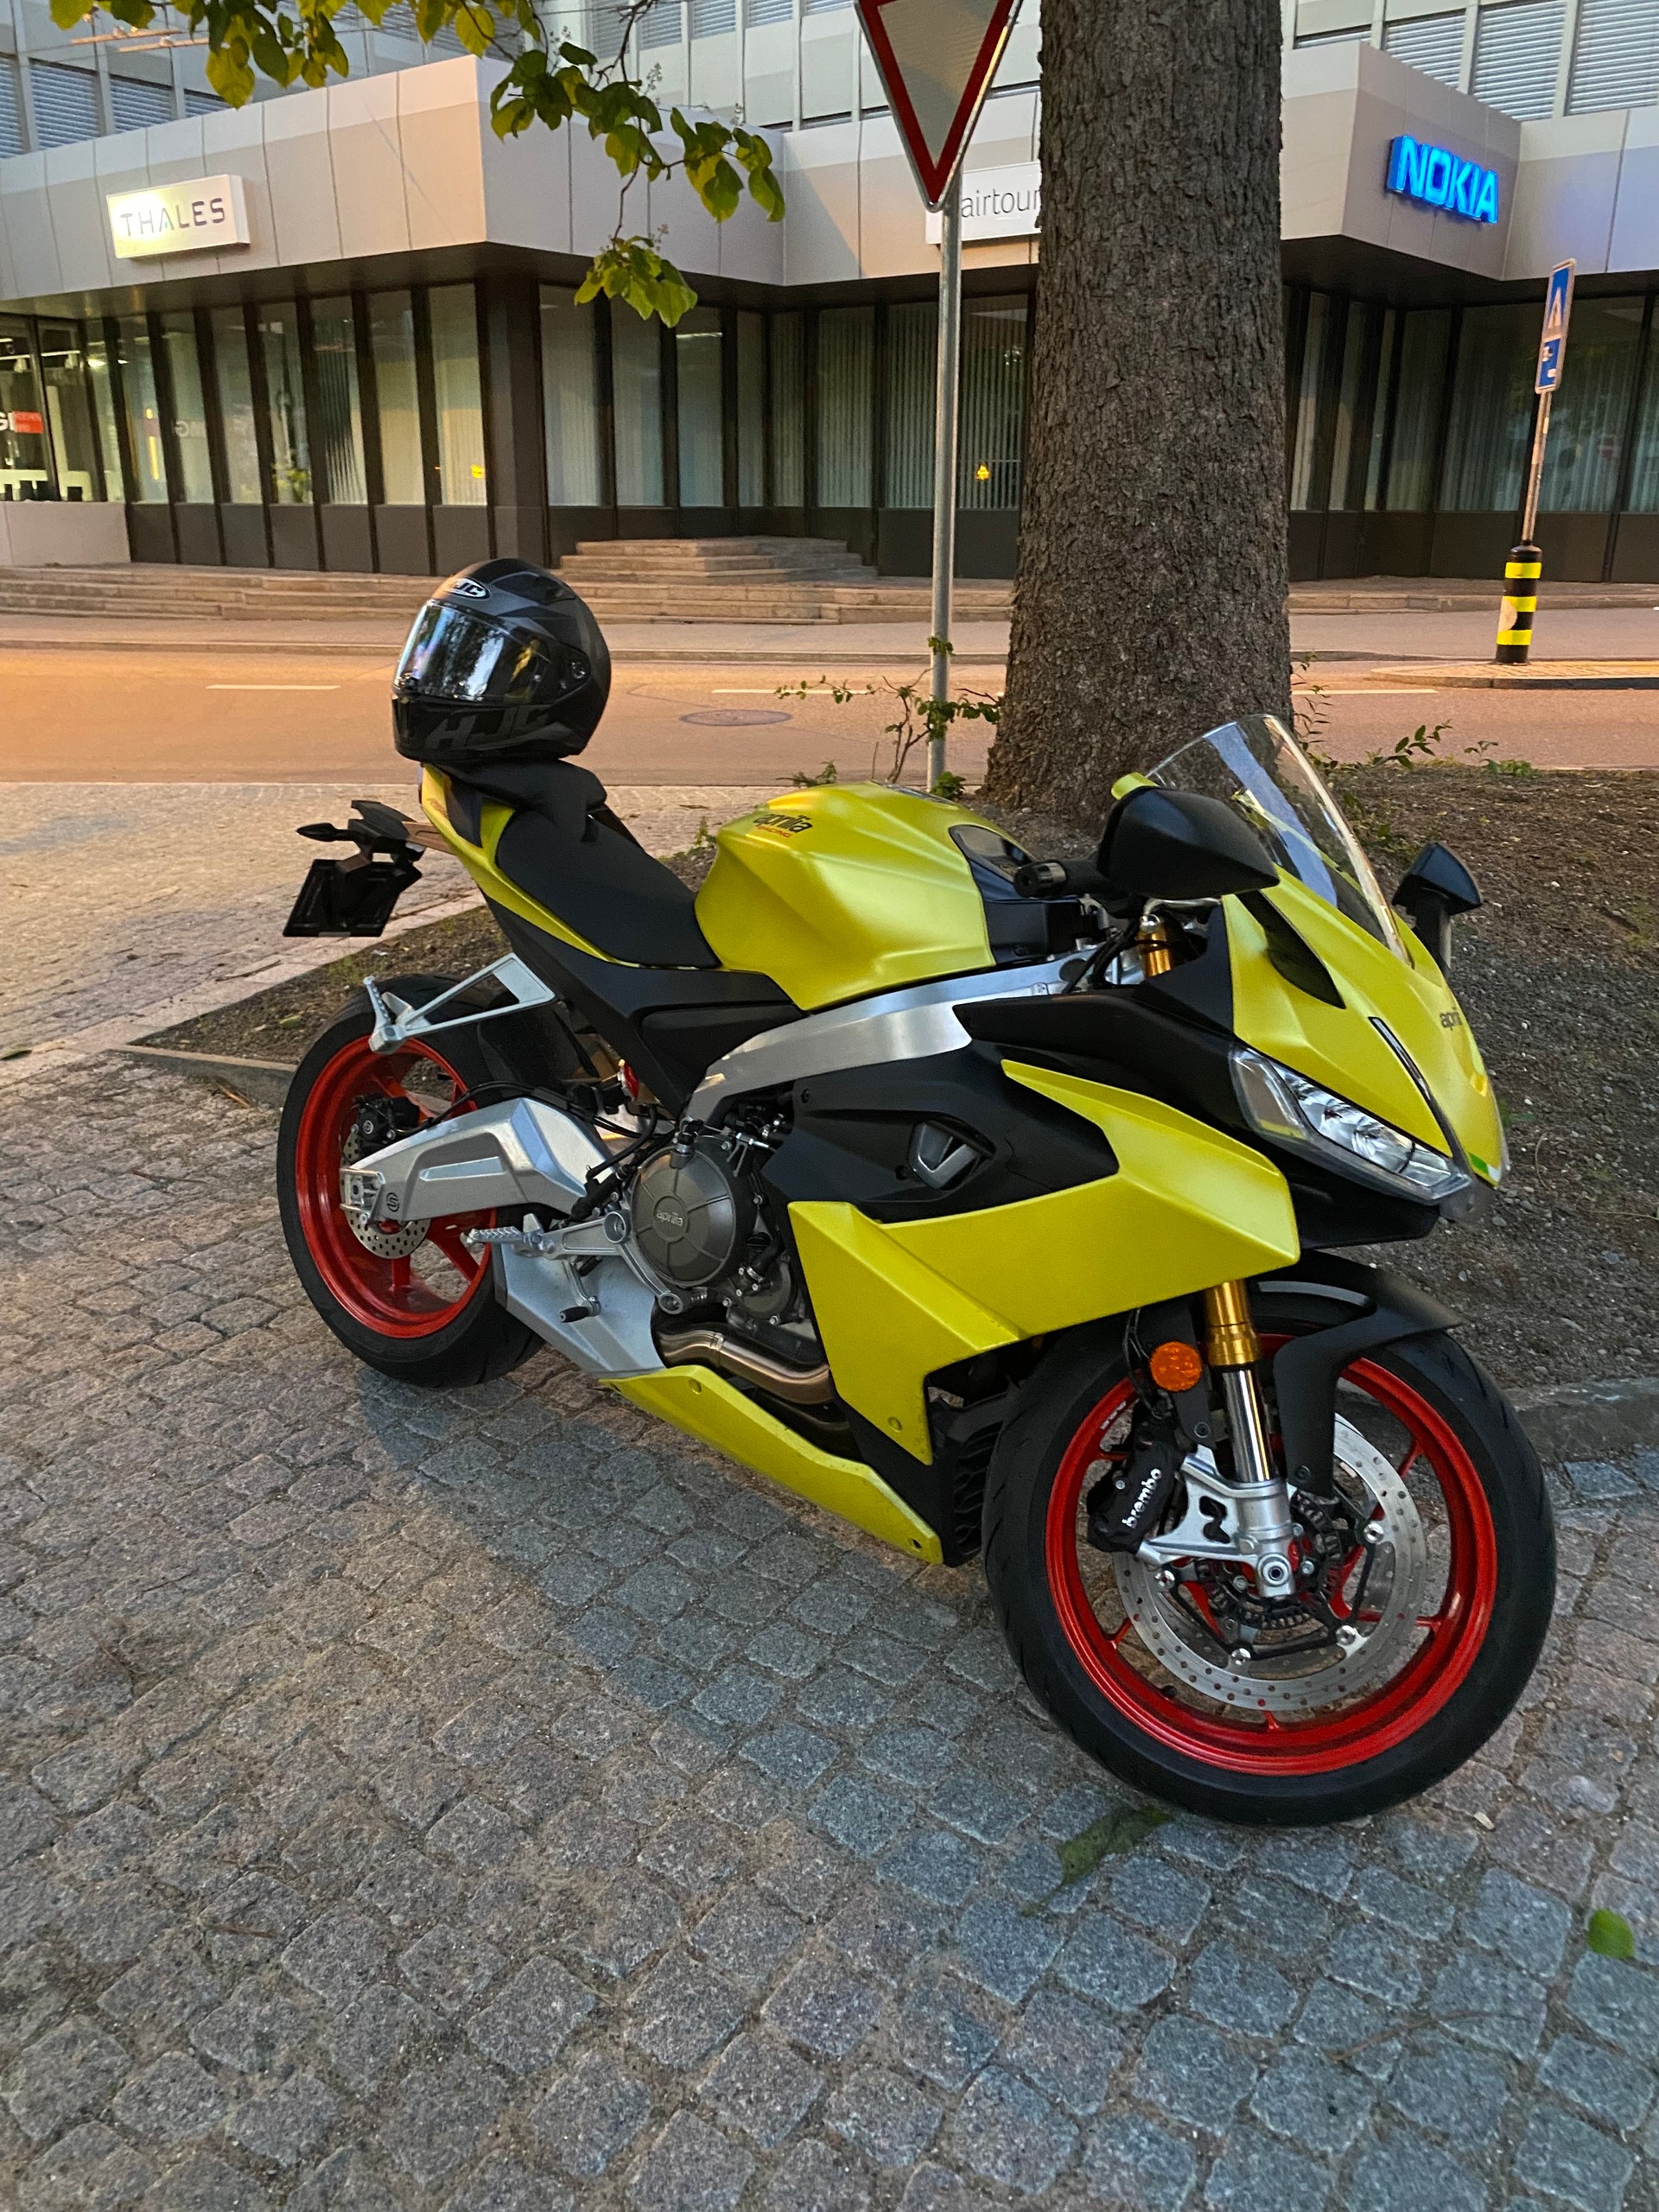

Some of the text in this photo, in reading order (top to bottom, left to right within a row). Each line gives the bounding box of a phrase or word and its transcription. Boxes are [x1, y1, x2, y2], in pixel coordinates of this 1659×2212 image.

[1395, 135, 1498, 223] NOKIA
[120, 197, 226, 237] THALES
[448, 581, 485, 596] JC
[424, 705, 550, 749] HJC
[753, 813, 813, 834] aprilia
[656, 1211, 683, 1226] aprilia
[1122, 1468, 1162, 1529] brembo
